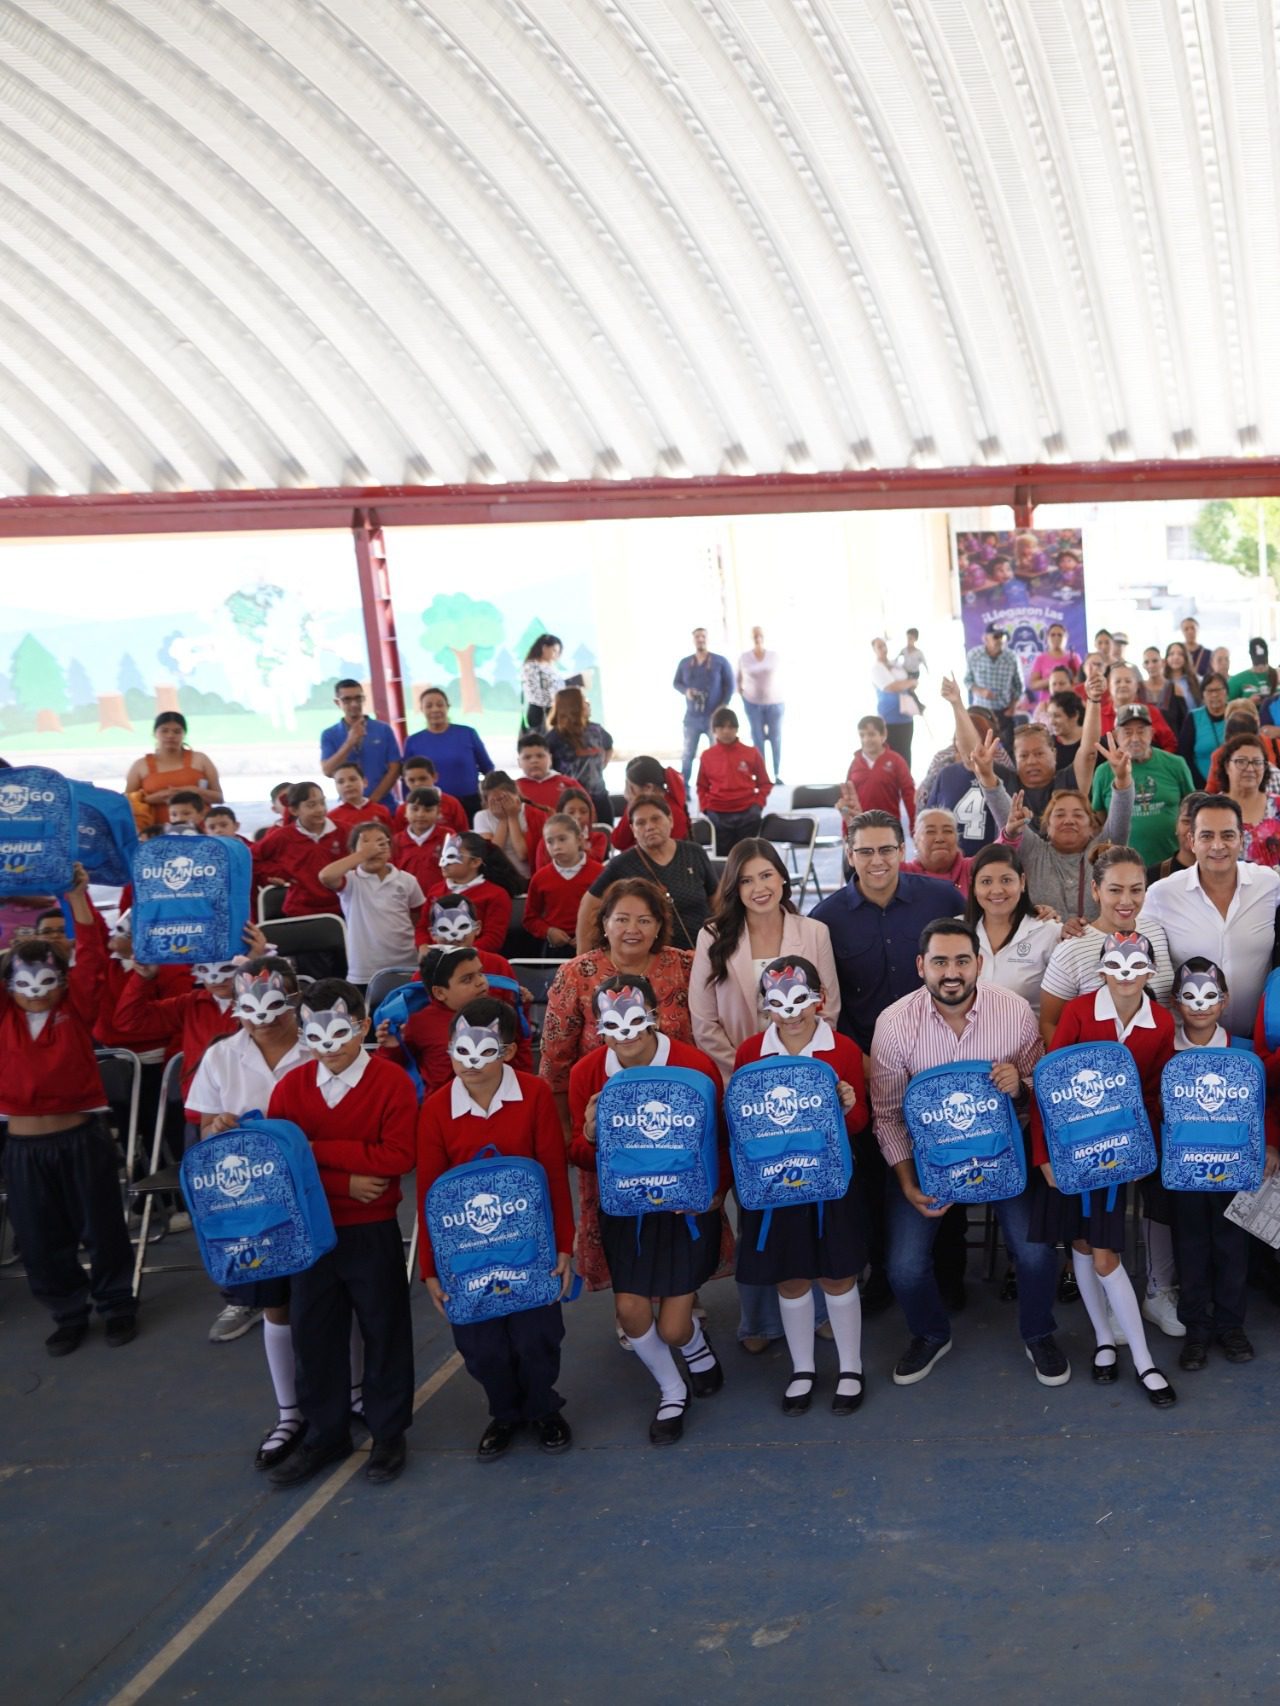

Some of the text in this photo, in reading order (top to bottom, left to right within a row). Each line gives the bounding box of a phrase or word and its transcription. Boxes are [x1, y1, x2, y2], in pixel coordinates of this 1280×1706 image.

[1129, 705, 1141, 717] T
[953, 787, 987, 840] 4
[143, 865, 217, 880] DURANGO
[1051, 1074, 1126, 1104] DURANGO
[1174, 1086, 1250, 1099] DURANGO
[741, 1094, 822, 1117] DURANGO
[922, 1098, 999, 1125] DURANGO
[612, 1114, 695, 1128] DURANGO
[1074, 1134, 1129, 1160] MOCHULA
[1088, 1147, 1117, 1170] 30
[1183, 1152, 1240, 1164] MOCHULA
[193, 1162, 275, 1190] DURANGO
[762, 1157, 818, 1178] MOCHULA
[1194, 1162, 1227, 1179] 30
[617, 1175, 678, 1189] MOCHULA
[442, 1198, 527, 1229] DURANGO
[467, 1269, 528, 1292] MOCHULA
